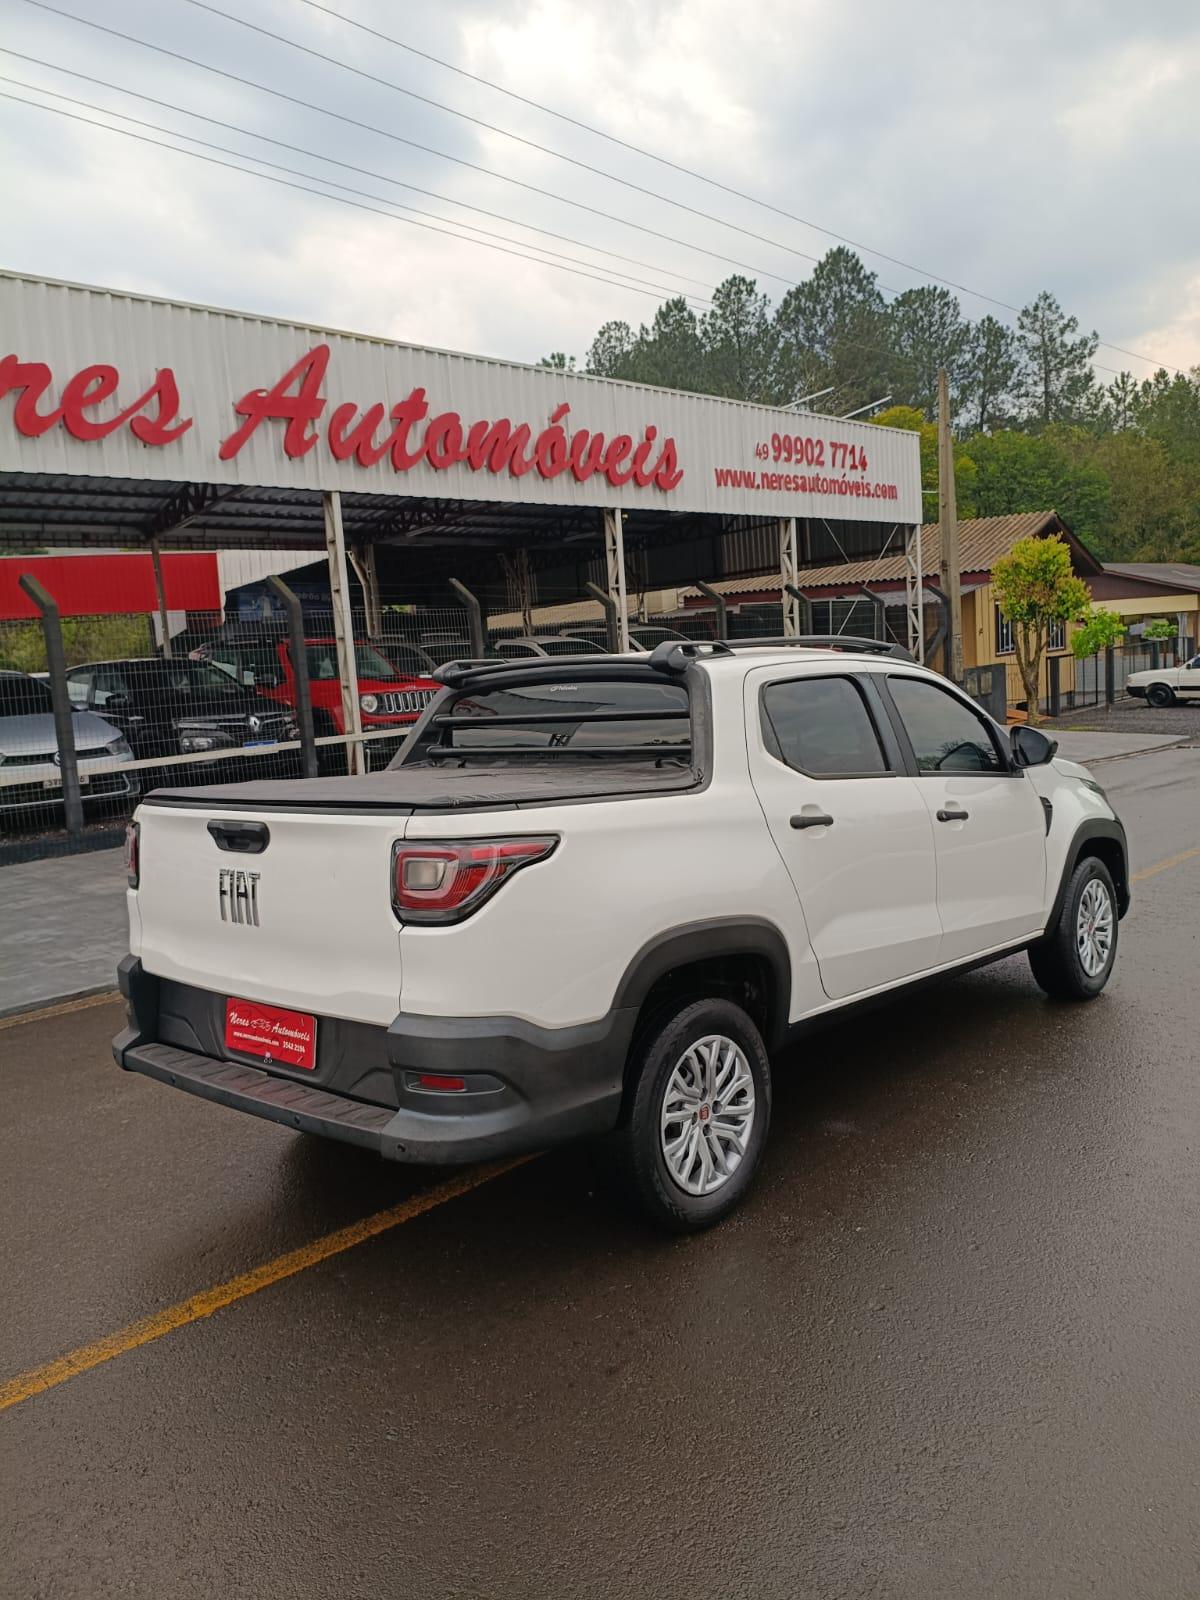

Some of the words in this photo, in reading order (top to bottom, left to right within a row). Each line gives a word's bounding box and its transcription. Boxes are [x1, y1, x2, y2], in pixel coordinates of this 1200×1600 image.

[219, 344, 684, 491] Automóveis
[755, 442, 769, 460] 49
[771, 432, 825, 467] 99902
[829, 441, 868, 472] 7714
[714, 467, 898, 500] www.neresautomóveis.com
[219, 869, 261, 928] FIAT
